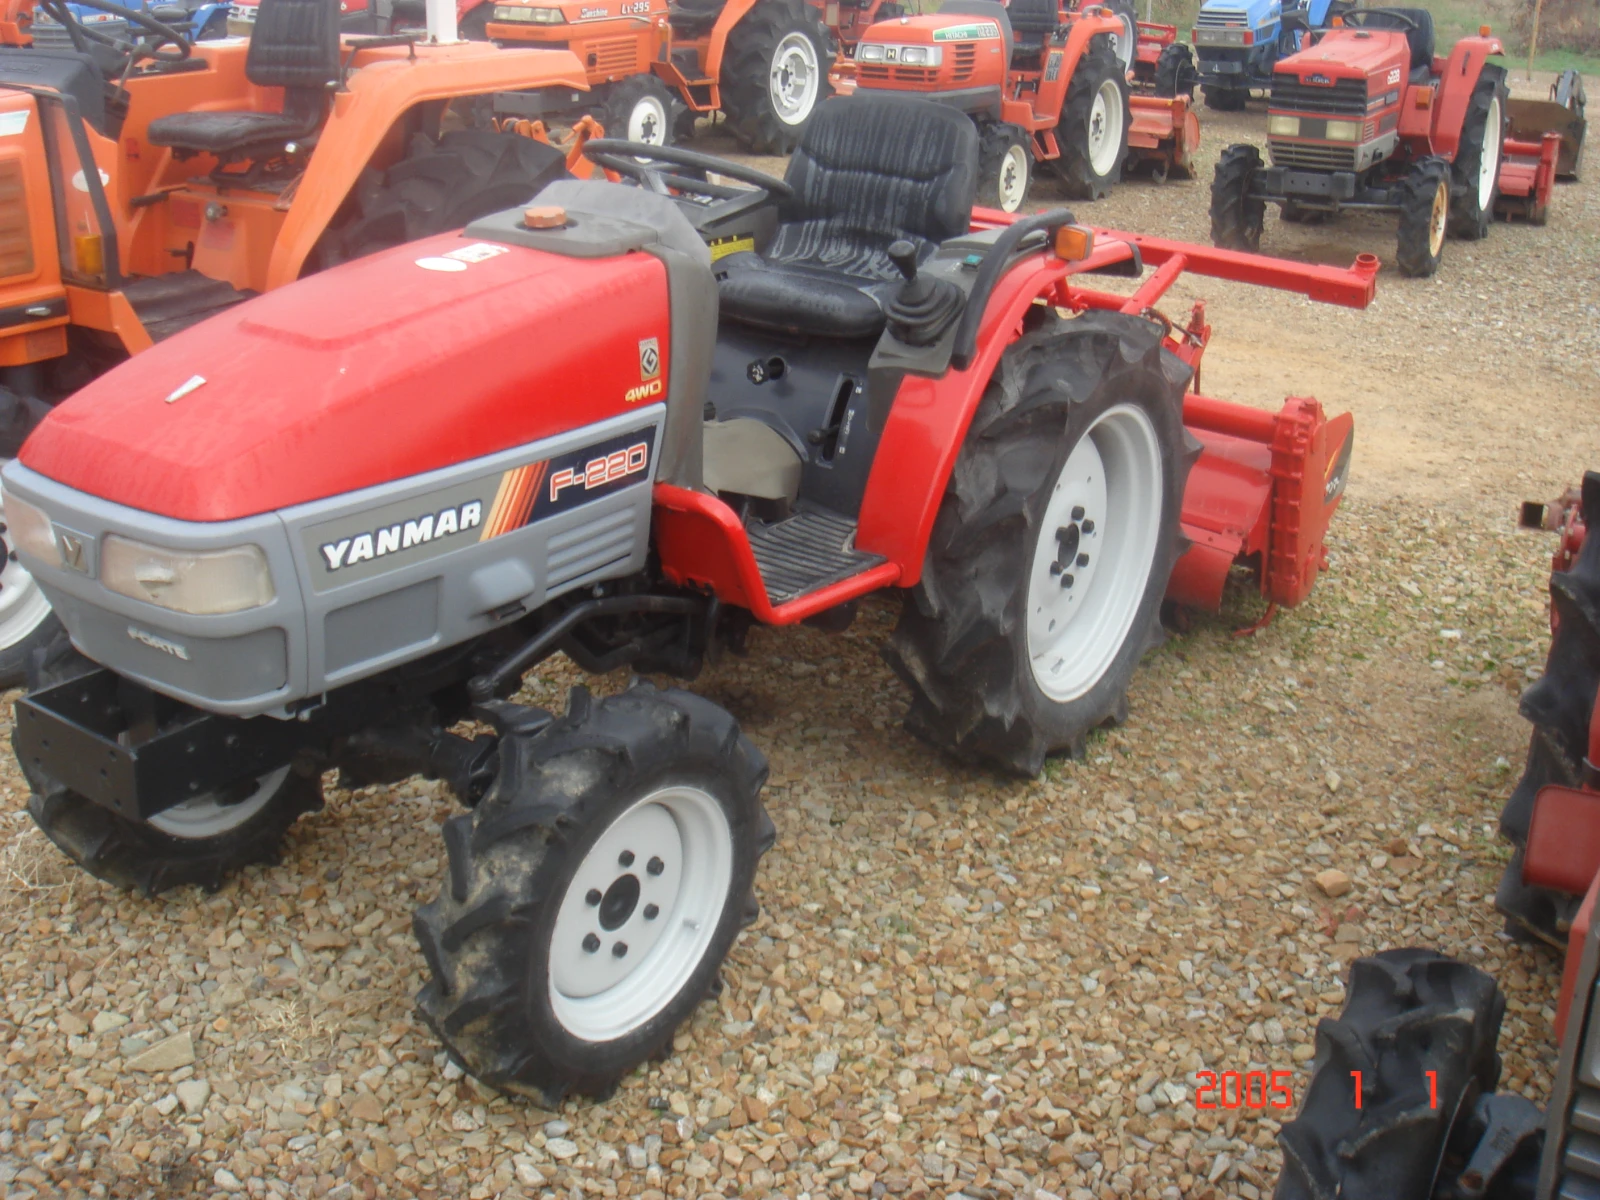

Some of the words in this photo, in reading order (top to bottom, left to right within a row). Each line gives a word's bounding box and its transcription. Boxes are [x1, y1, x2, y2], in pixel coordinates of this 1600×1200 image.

[944, 31, 968, 40] HITACHI
[624, 379, 662, 402] 4WD
[549, 442, 648, 502] F-220
[320, 499, 483, 571] YANMAR
